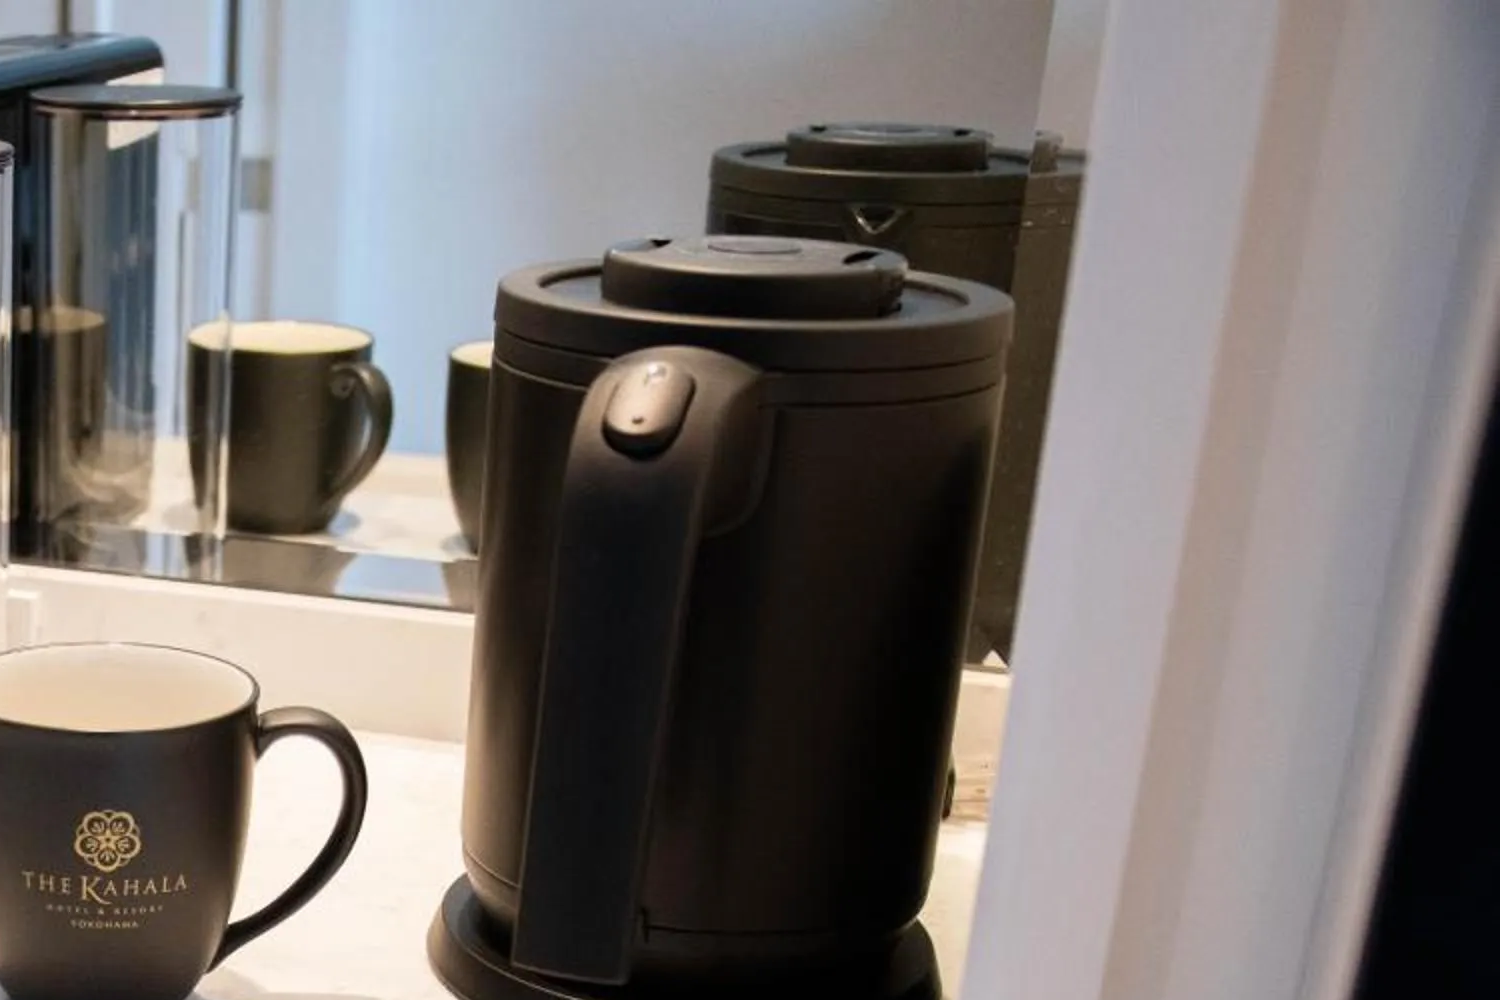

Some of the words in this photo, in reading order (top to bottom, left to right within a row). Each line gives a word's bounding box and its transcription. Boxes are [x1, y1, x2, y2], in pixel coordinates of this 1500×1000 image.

[21, 870, 72, 895] THE
[79, 873, 188, 905] KAHALA
[69, 918, 140, 929] YOKOHAMA
